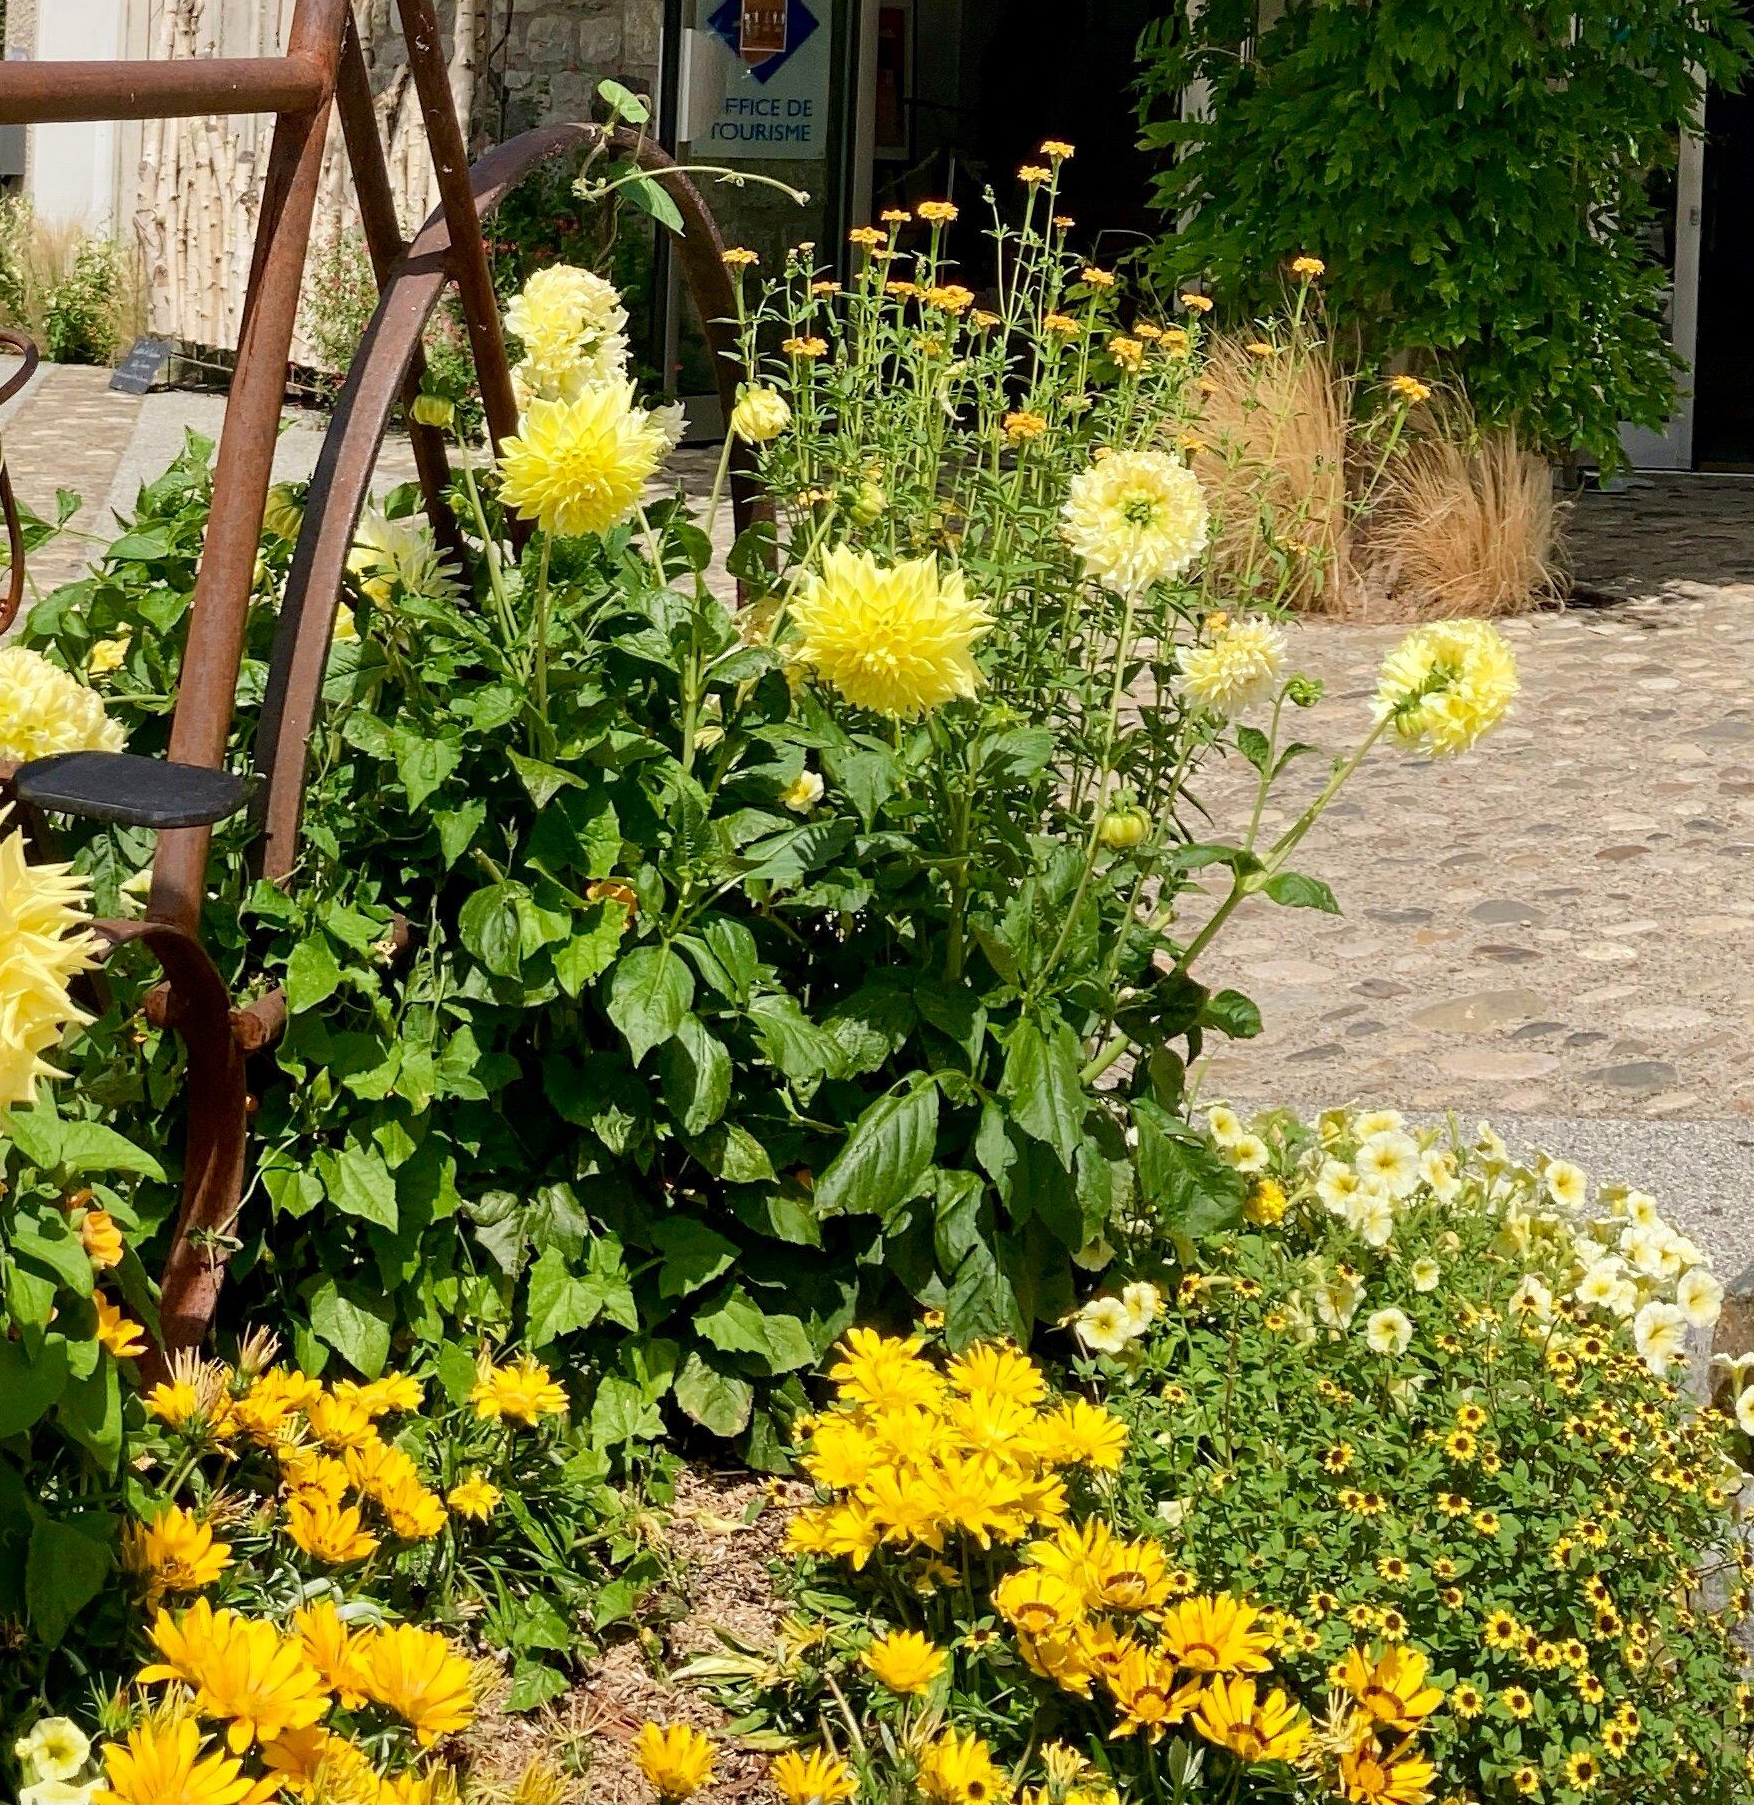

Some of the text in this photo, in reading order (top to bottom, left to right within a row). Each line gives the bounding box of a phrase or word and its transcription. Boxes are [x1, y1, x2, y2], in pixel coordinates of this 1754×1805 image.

[724, 97, 813, 117] FFICE DE
[710, 122, 812, 142] TOURISME
